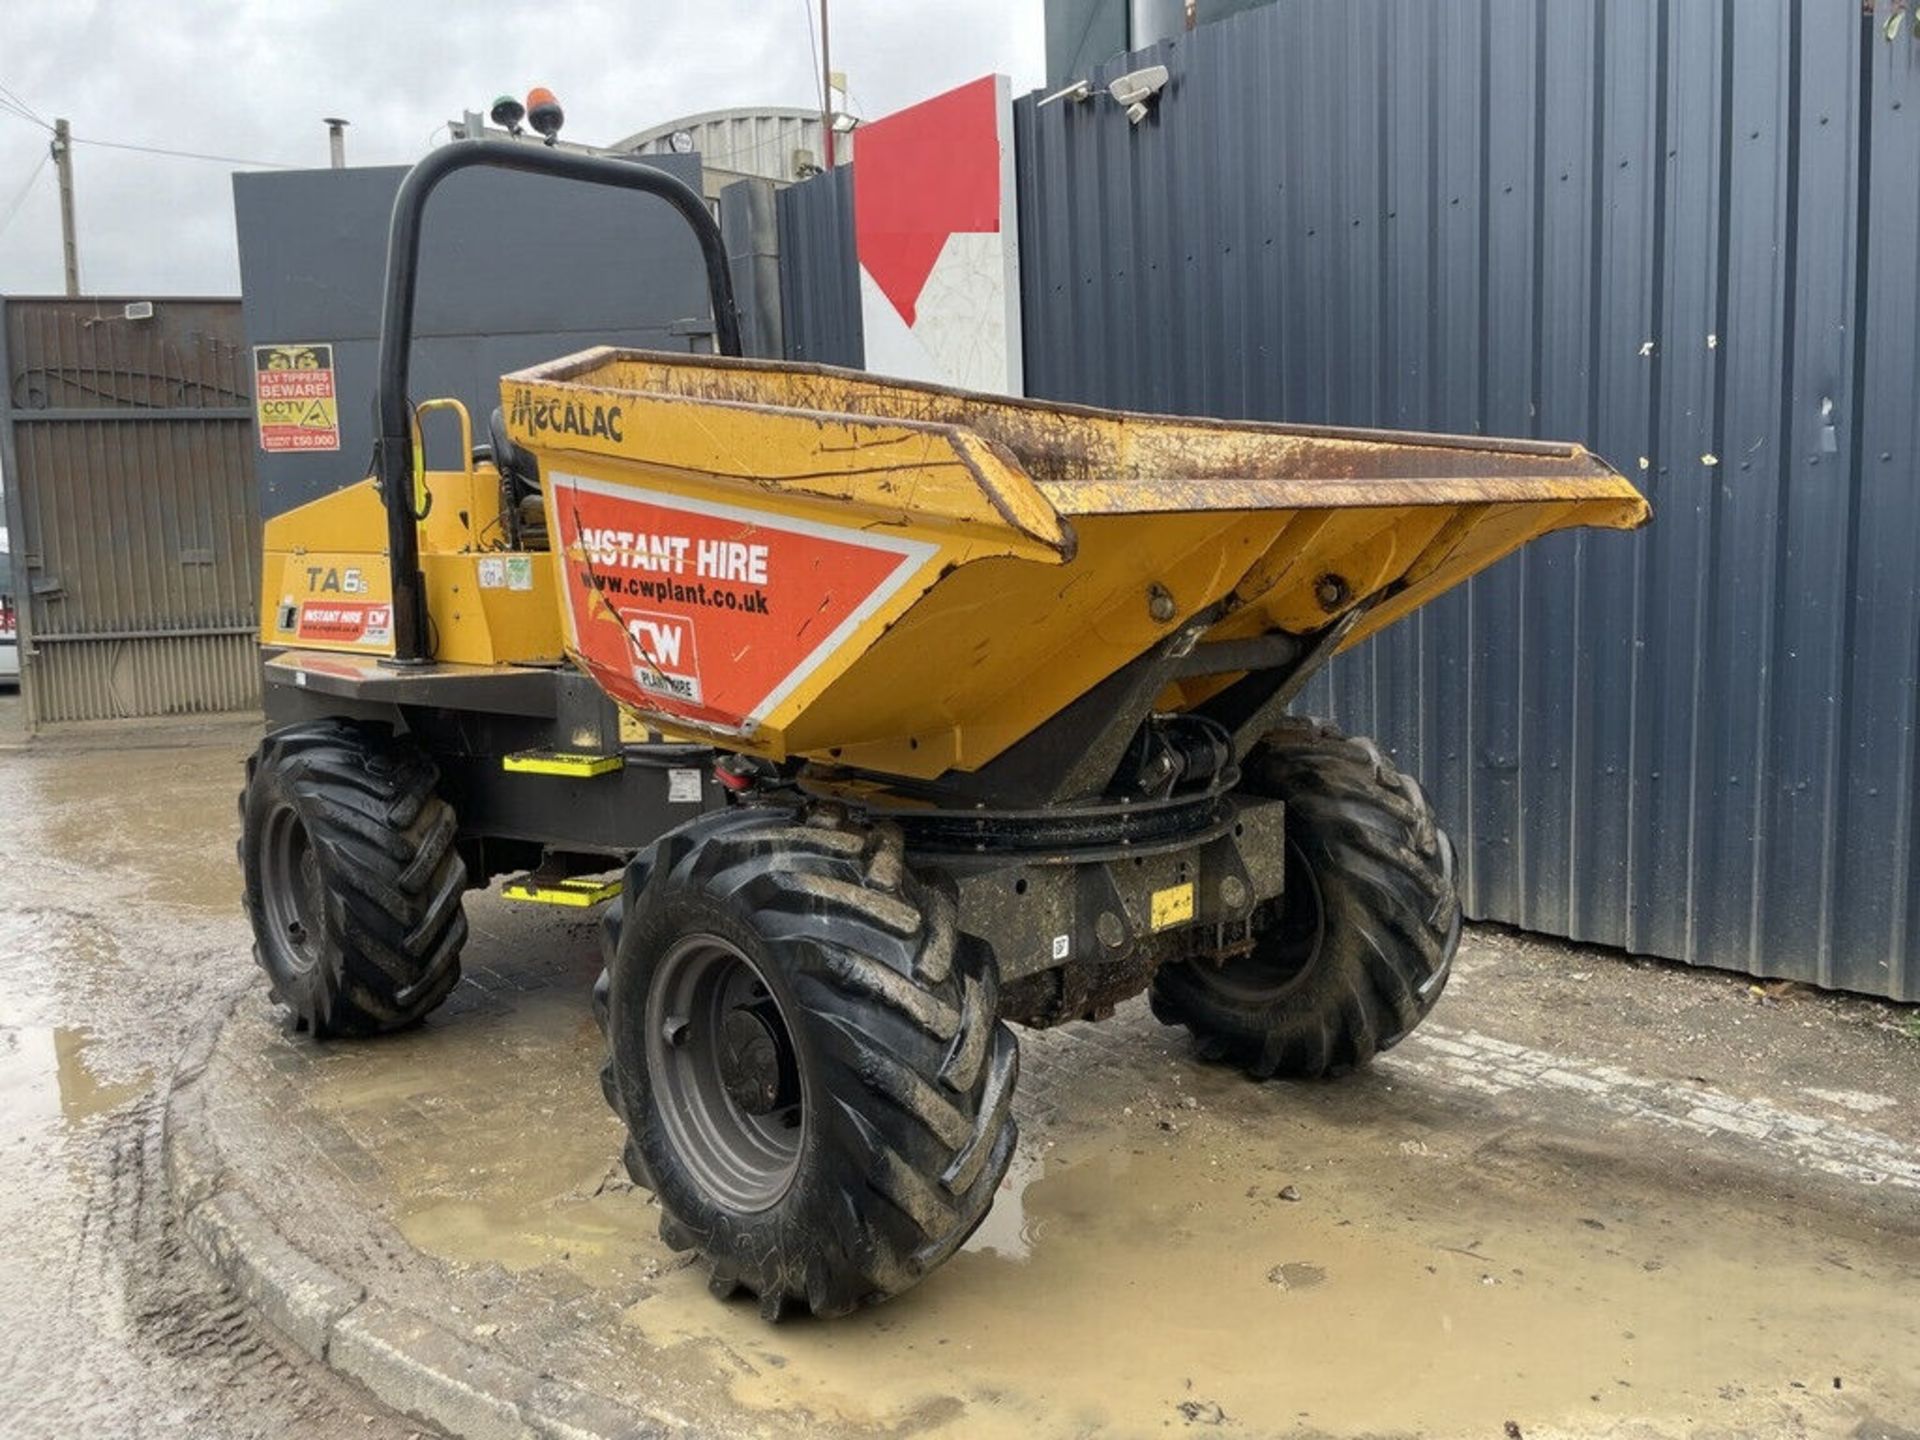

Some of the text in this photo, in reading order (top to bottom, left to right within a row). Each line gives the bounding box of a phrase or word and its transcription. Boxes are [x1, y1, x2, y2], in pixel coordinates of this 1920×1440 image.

[261, 383, 331, 398] BEWARE!
[263, 401, 304, 414] CCTV
[579, 528, 690, 574] NSTANT
[697, 539, 769, 585] HIRE
[581, 572, 769, 614] www.cwplant.co.uk
[629, 619, 682, 667] CW
